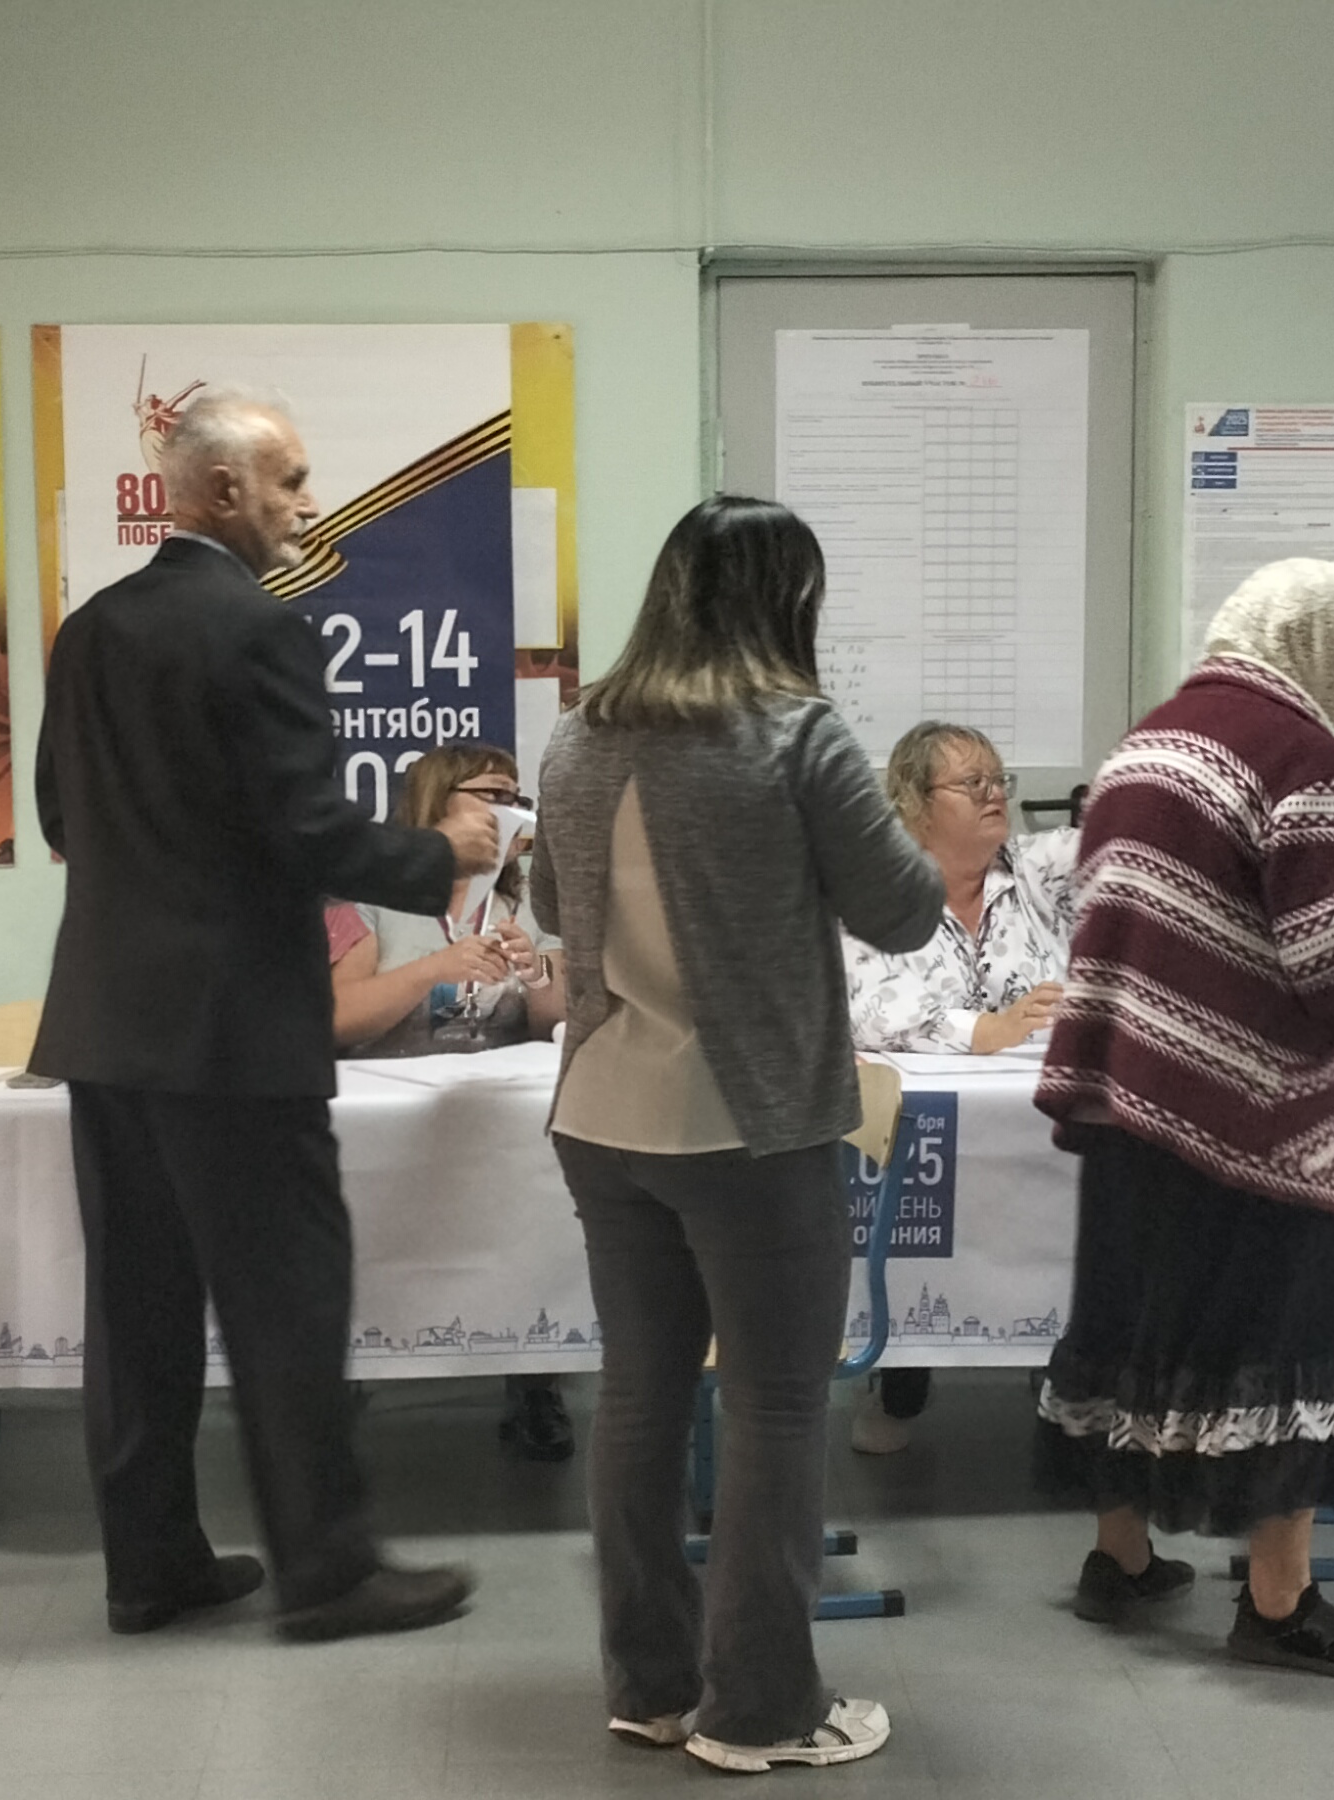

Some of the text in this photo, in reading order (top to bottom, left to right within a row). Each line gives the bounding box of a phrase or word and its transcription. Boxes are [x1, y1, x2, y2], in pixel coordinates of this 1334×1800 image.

[116, 472, 166, 517] 80
[117, 524, 172, 546] ПОБЕ
[304, 609, 479, 694] 2-14
[329, 697, 480, 747] нтября
[895, 1196, 942, 1221] ЕНЬ
